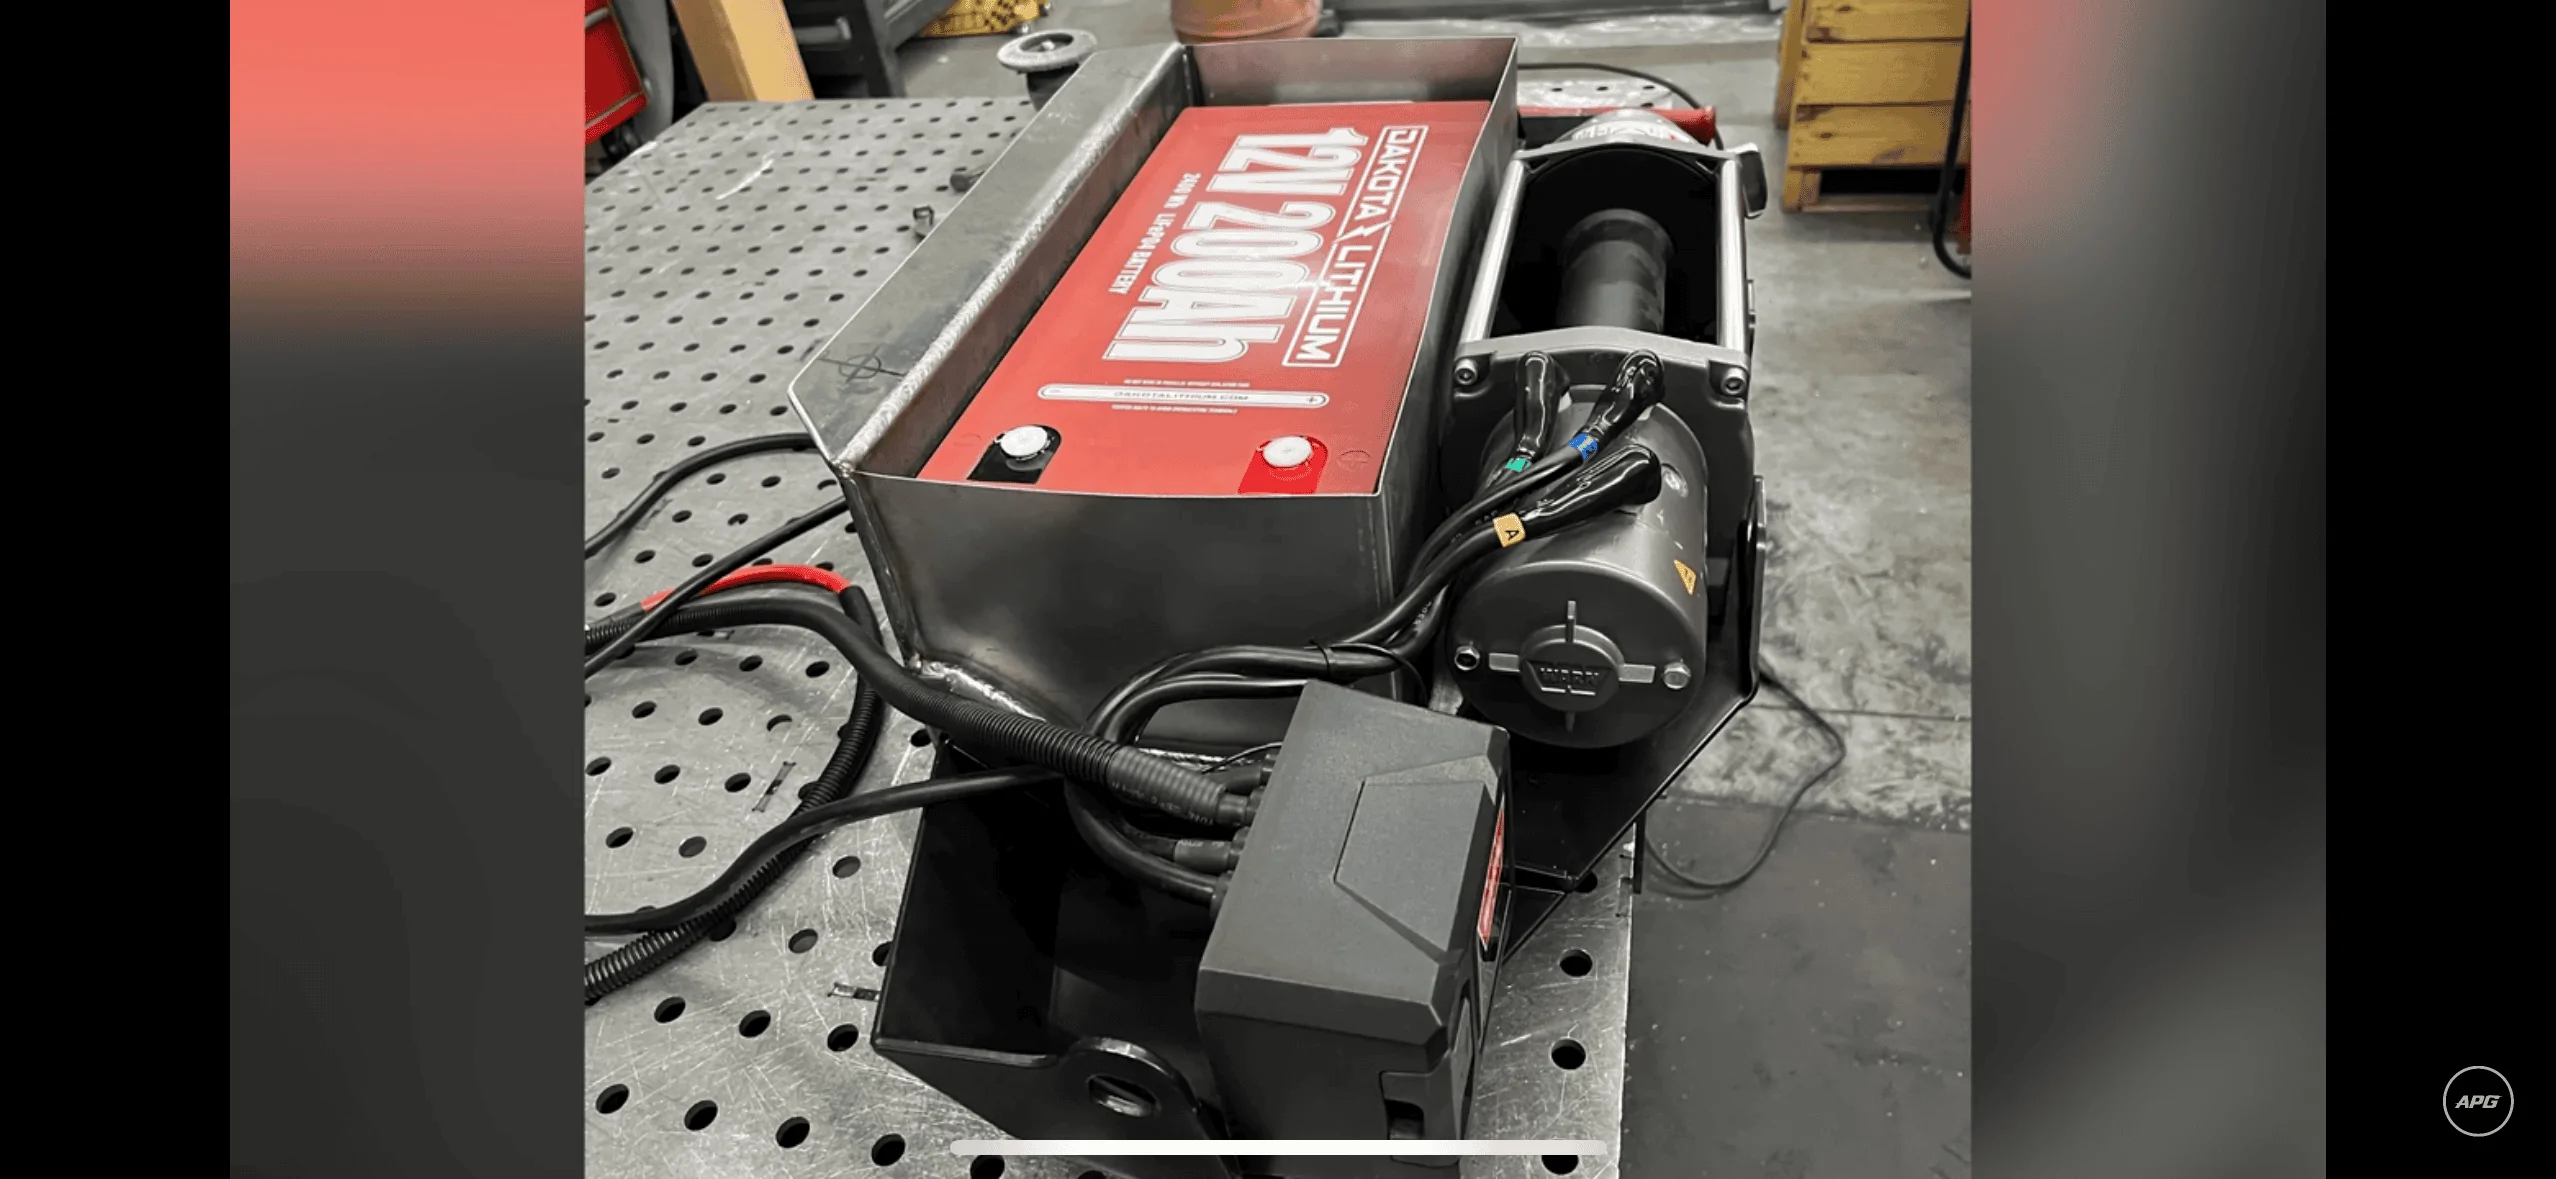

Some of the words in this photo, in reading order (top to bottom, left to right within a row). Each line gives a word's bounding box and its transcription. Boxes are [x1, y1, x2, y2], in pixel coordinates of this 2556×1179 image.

[1207, 126, 1369, 197] 12V
[1355, 129, 1419, 222] DAKOTA
[1101, 201, 1335, 364] 200Ah
[1108, 250, 1153, 295] BATTERY
[1296, 244, 1371, 361] LITHIUM
[1504, 528, 1520, 541] A
[1539, 666, 1600, 685] WARN
